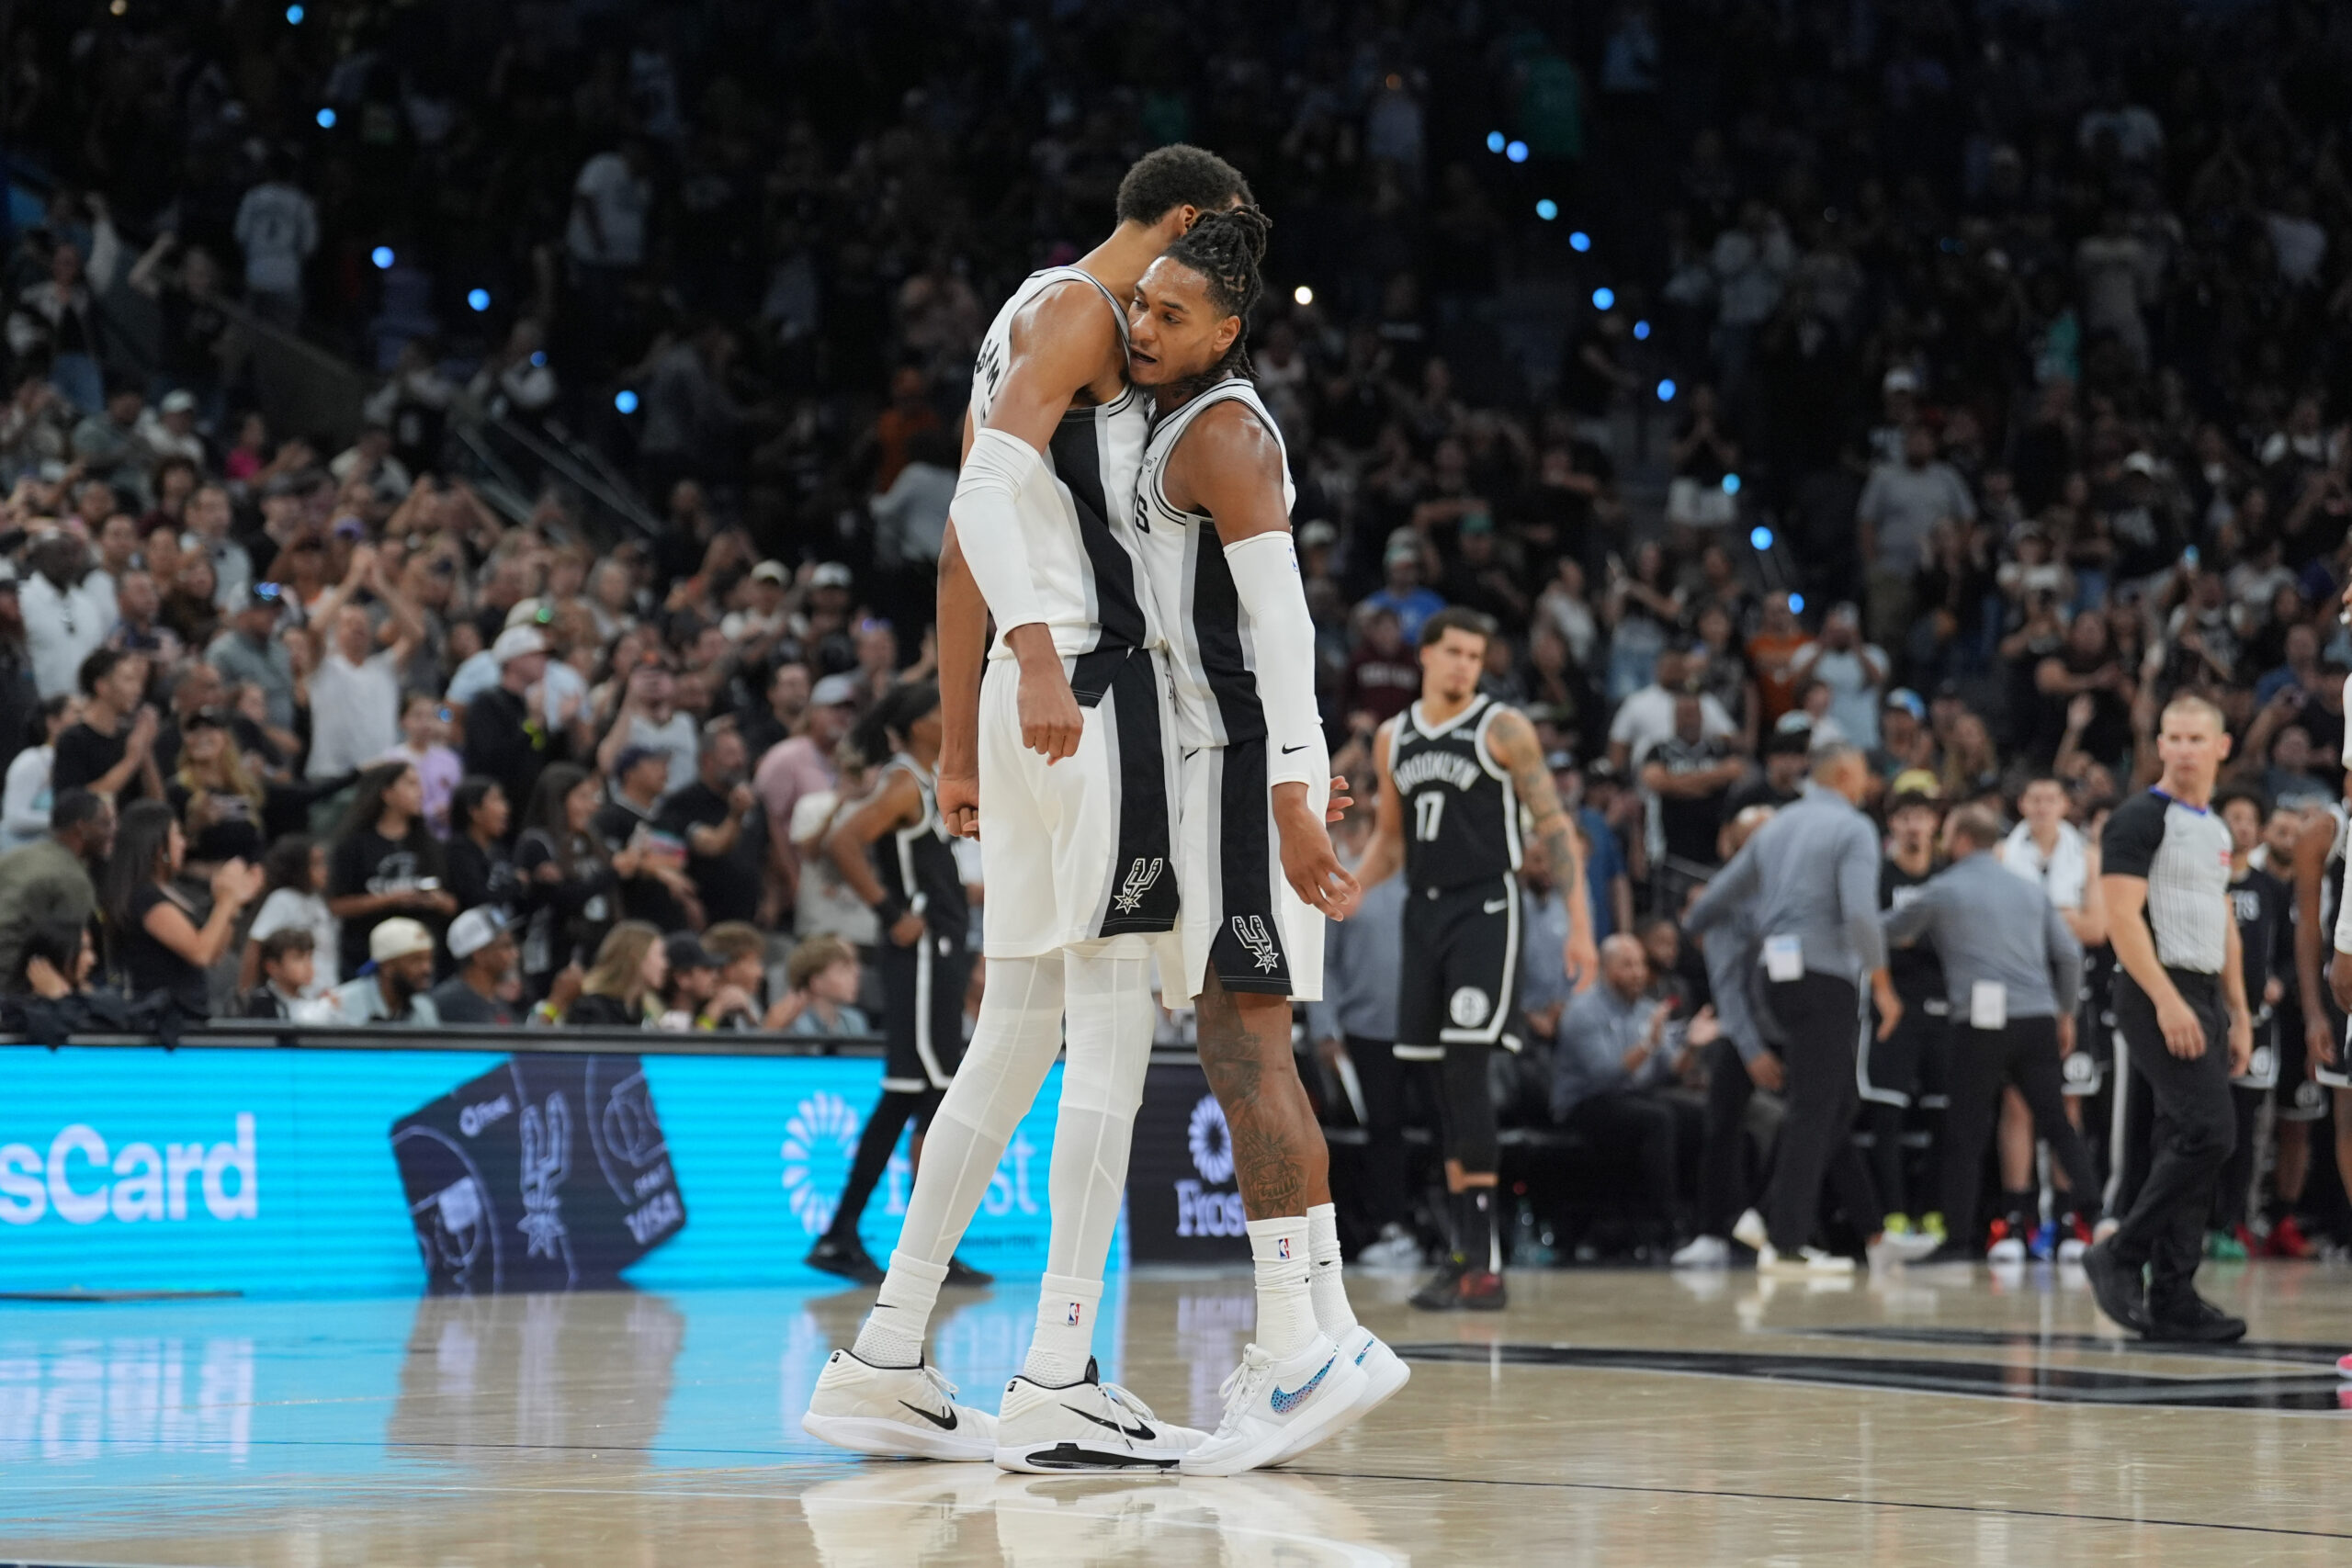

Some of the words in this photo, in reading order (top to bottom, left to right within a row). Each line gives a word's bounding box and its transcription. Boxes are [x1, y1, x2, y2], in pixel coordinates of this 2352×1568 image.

[1393, 750, 1481, 795] BROOKLYN
[1415, 790, 1445, 842] 17
[0, 1111, 257, 1224] sCard
[1174, 1179, 1248, 1236] Fros
